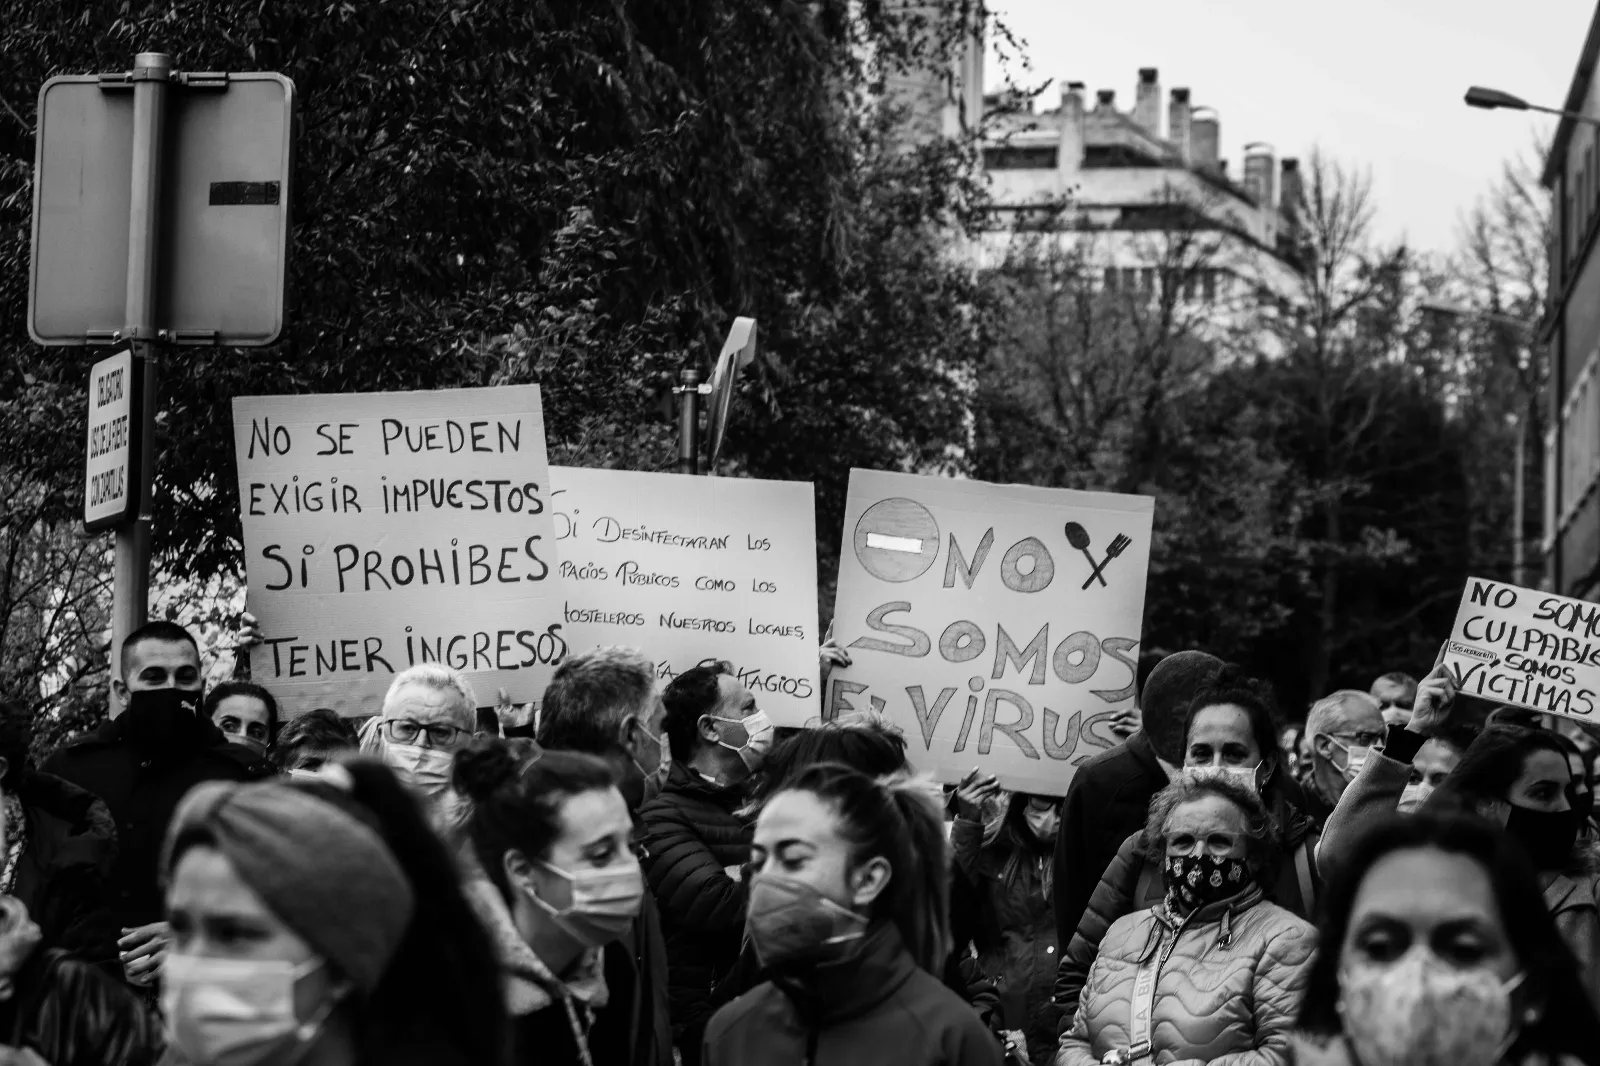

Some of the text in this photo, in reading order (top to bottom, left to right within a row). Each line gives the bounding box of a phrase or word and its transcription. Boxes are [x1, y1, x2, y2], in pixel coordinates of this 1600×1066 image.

[248, 416, 521, 459] NO SE PUEDEN
[747, 533, 771, 551] LOS
[943, 526, 1056, 594] NO
[695, 575, 736, 593] COMO
[752, 578, 777, 593] LOS
[1470, 581, 1518, 609] NO
[659, 611, 736, 633] NUESTROS
[264, 636, 395, 677] TENER
[847, 600, 1140, 703] SOMOS
[1503, 652, 1577, 685] SOMOS
[829, 678, 887, 721] E
